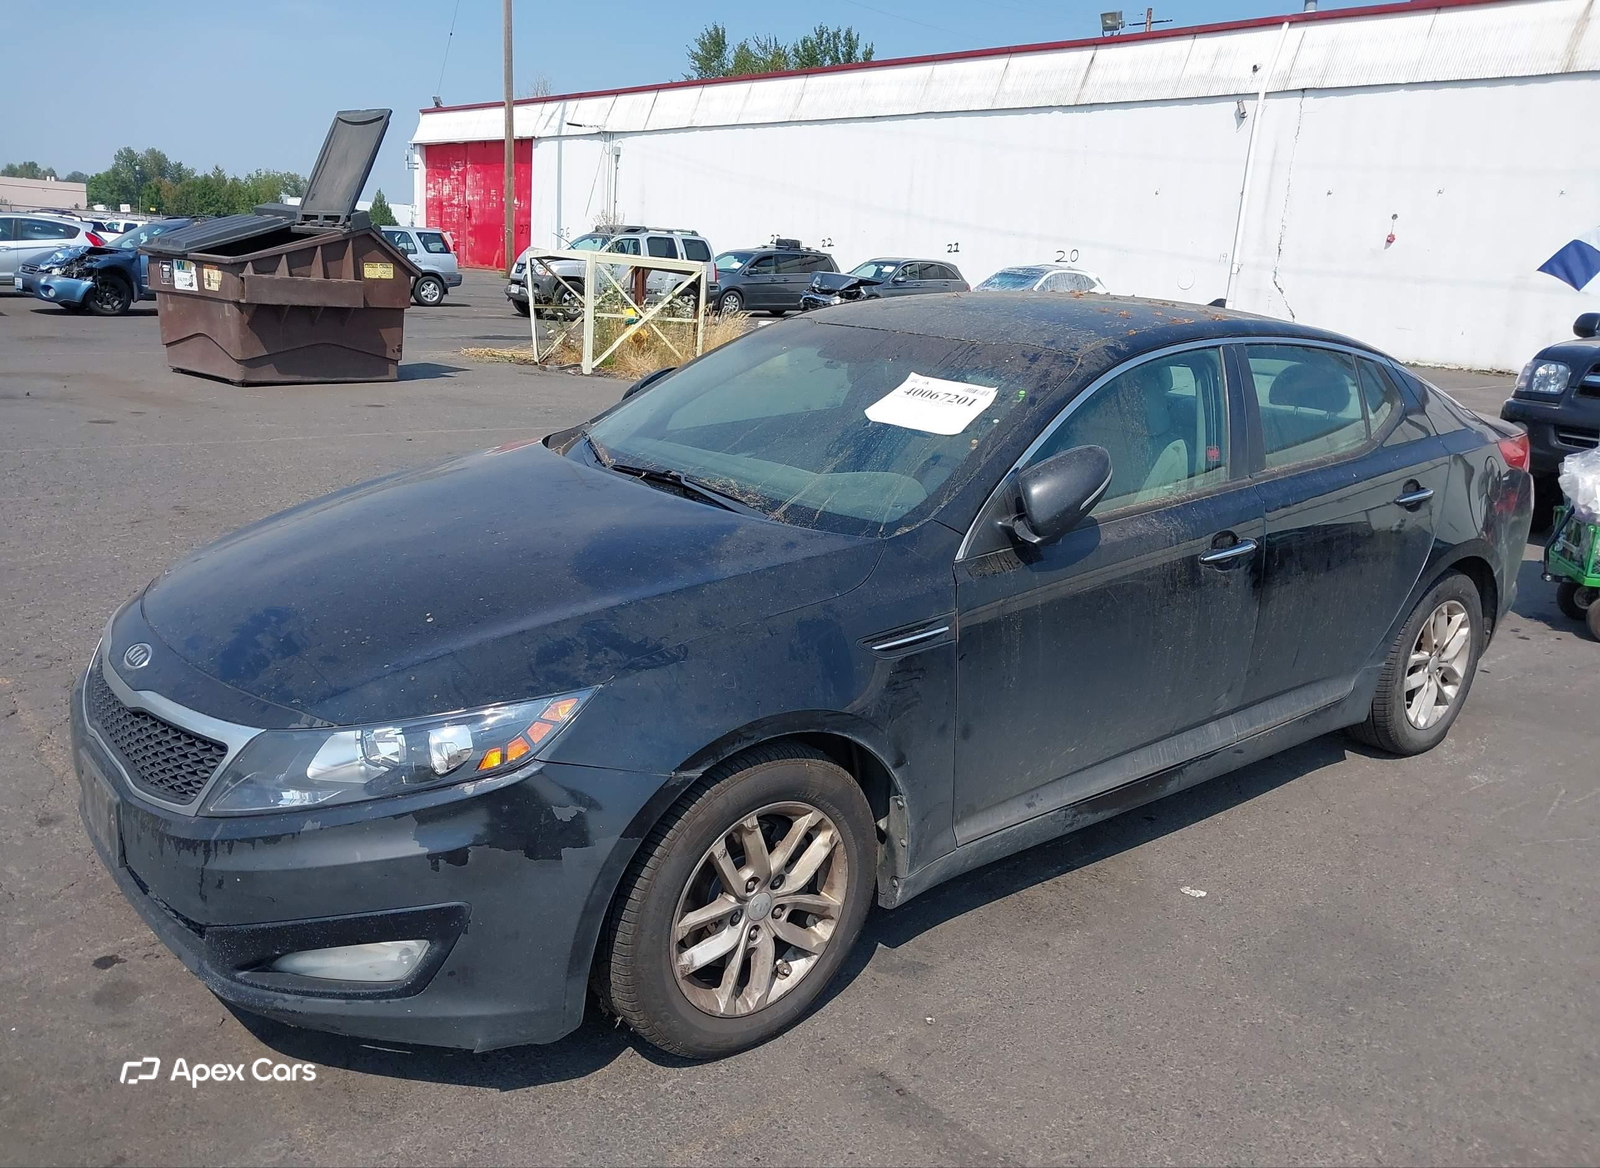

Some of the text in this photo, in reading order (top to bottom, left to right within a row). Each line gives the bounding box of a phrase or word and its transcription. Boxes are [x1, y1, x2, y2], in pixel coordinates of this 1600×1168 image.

[520, 224, 529, 235] 27
[821, 237, 835, 248] 22
[946, 242, 960, 253] 21
[1055, 249, 1079, 263] 20
[904, 387, 978, 407] 40067201
